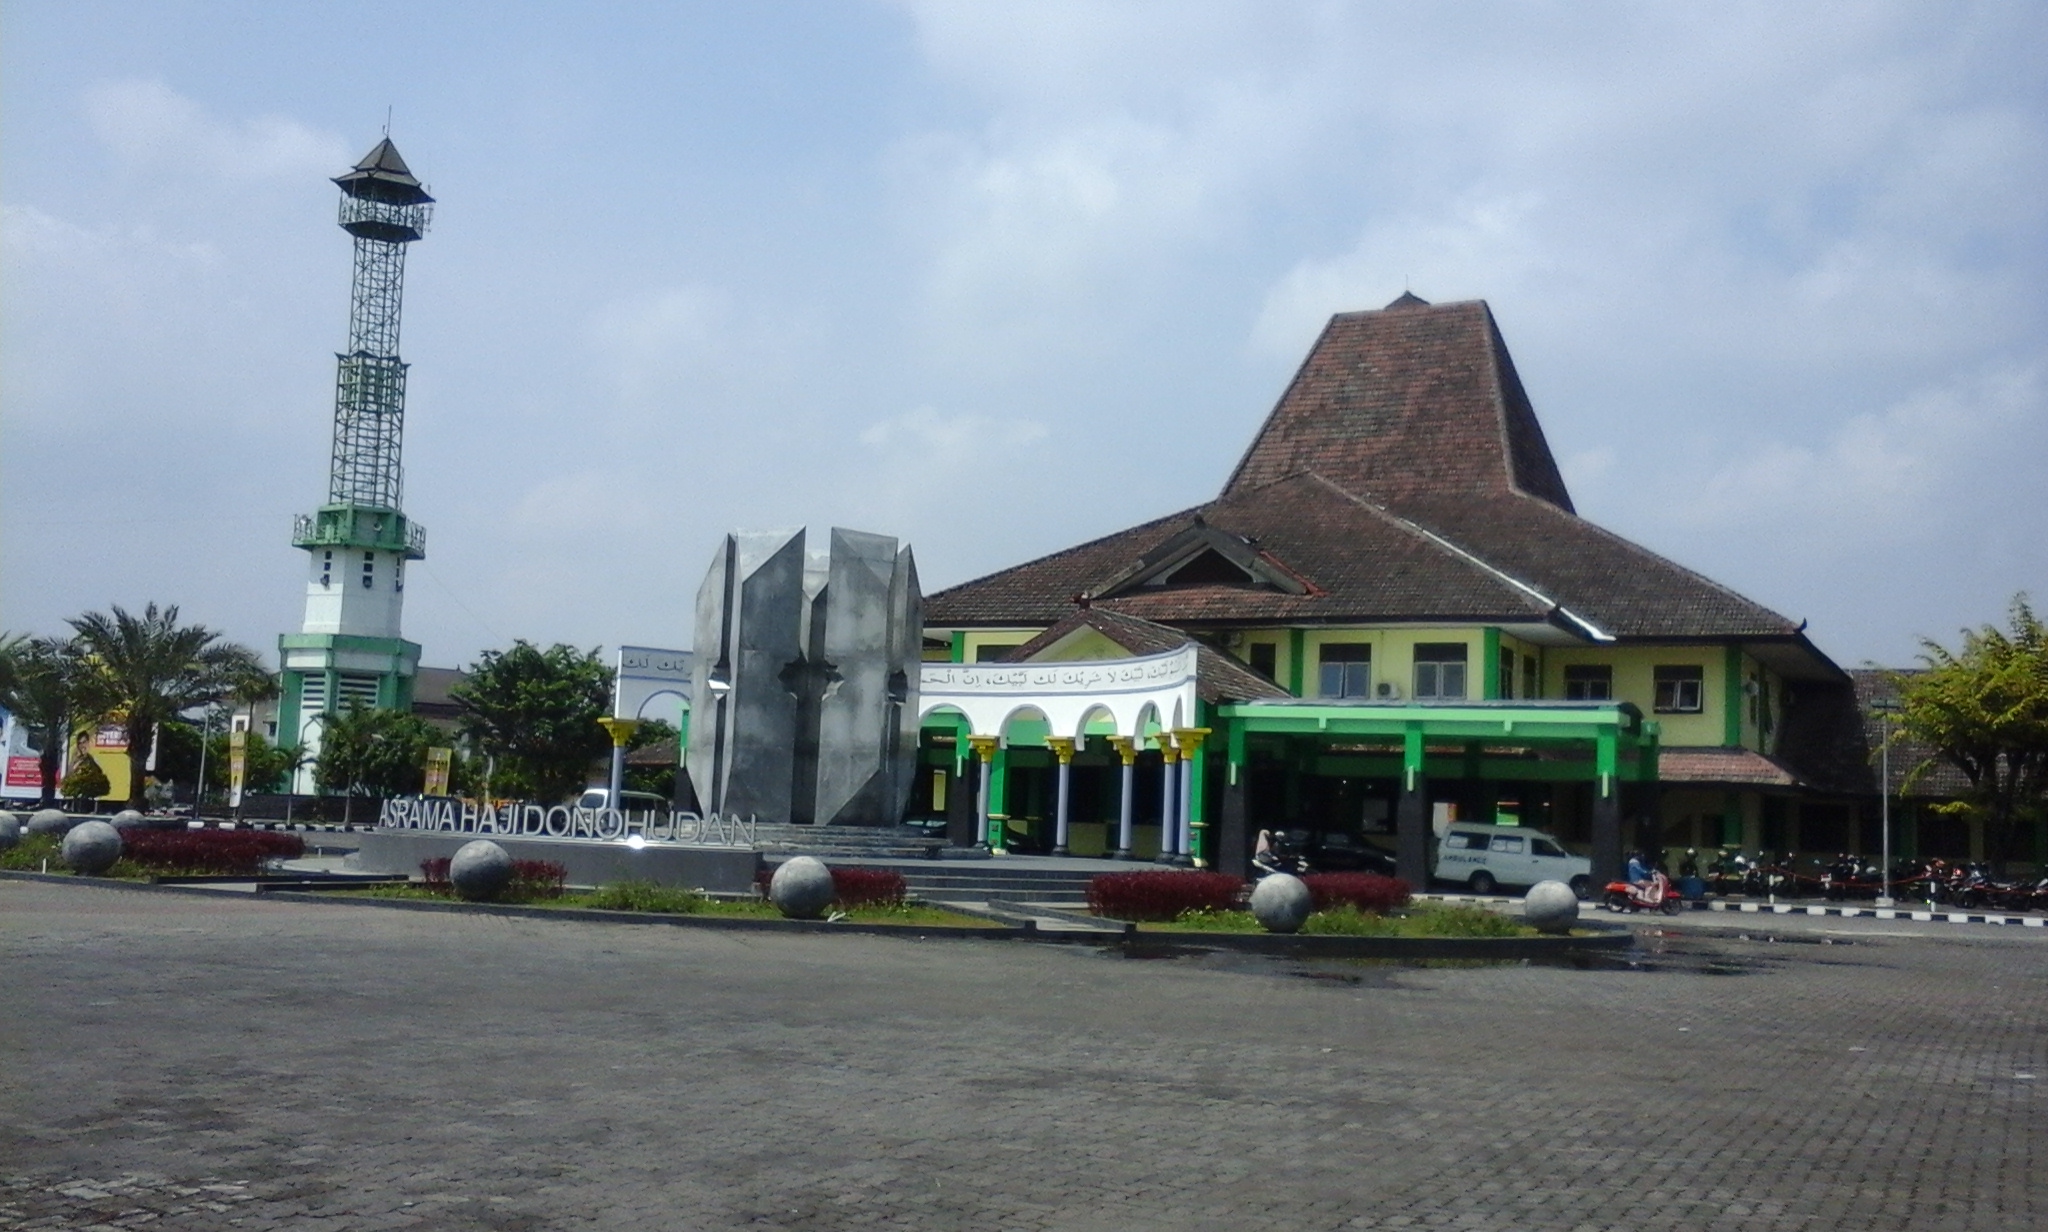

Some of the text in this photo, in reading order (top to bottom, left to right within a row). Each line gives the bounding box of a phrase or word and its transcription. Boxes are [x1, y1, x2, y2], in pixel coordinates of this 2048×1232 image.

[378, 798, 757, 846] ASRAMA HAJI DONOHUDAN
